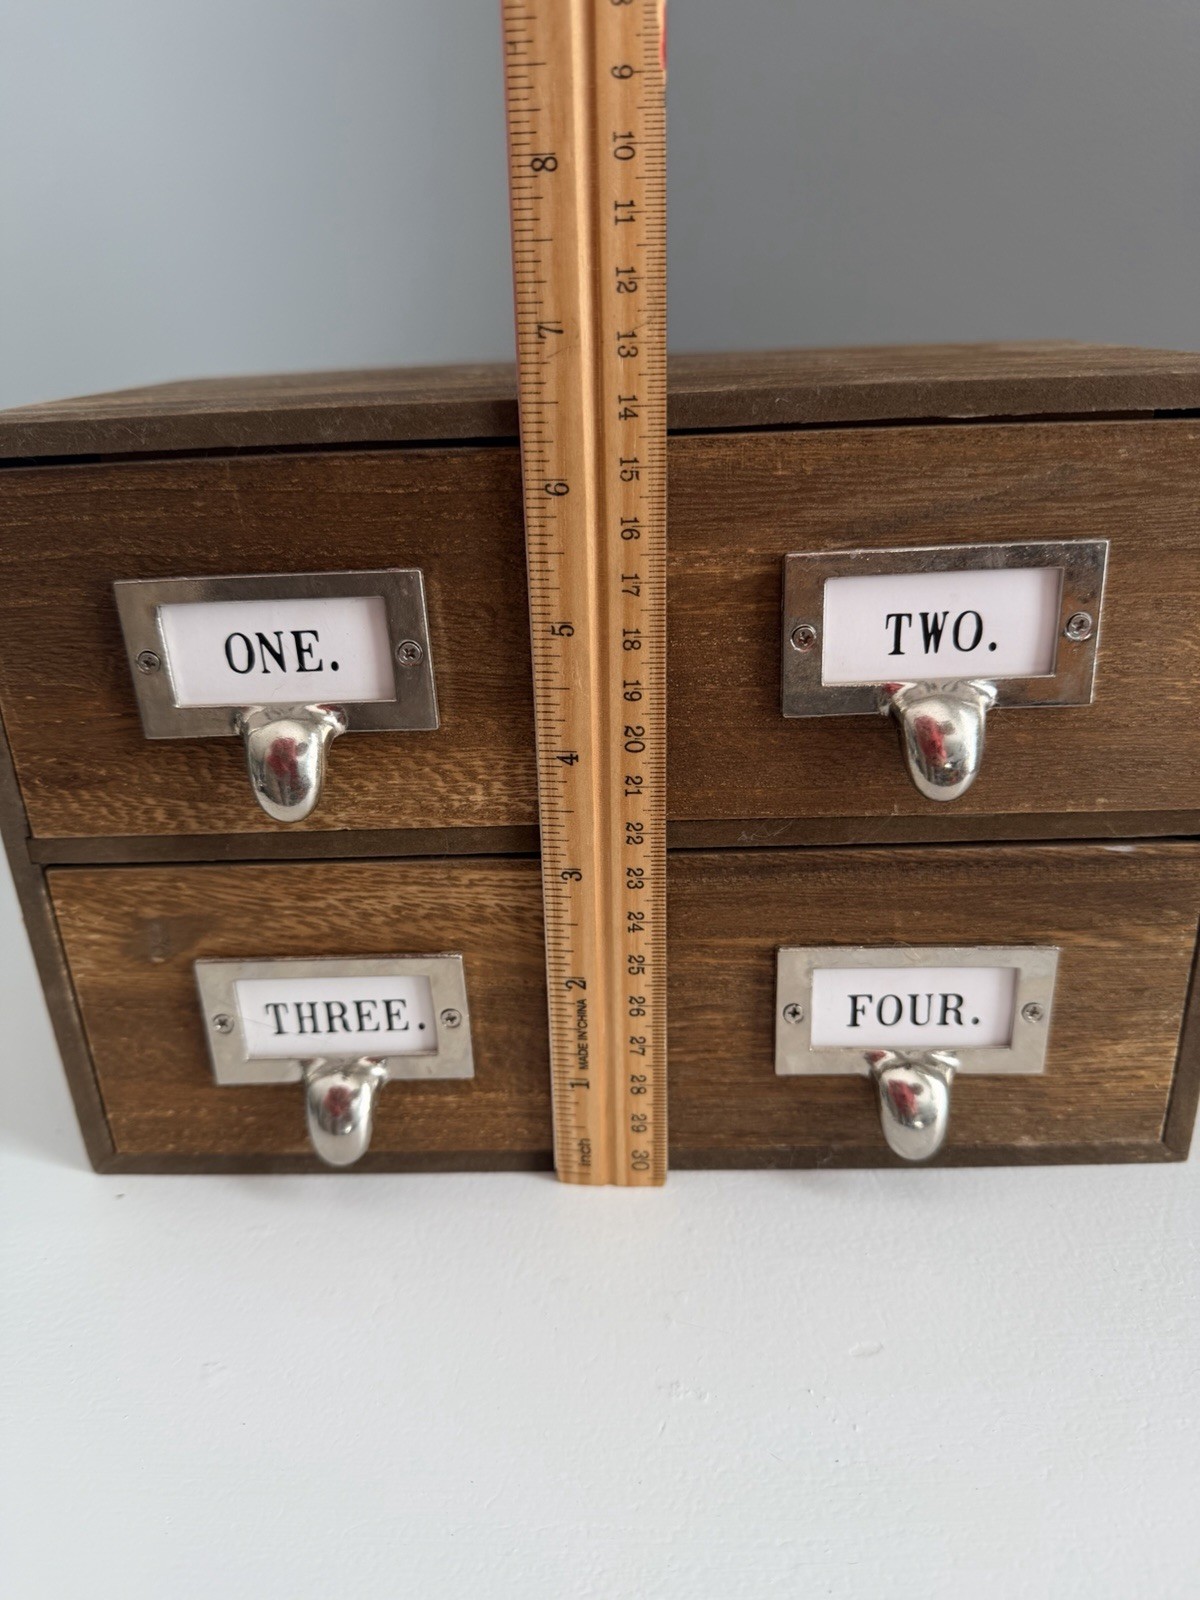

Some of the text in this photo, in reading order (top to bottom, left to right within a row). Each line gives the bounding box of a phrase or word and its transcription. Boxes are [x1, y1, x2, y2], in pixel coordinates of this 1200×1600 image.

[611, 64, 634, 79] 9
[613, 131, 636, 161] 10
[530, 156, 558, 172] 8
[614, 200, 636, 225] 11
[616, 267, 638, 294] 12
[537, 324, 564, 339] 7
[617, 331, 639, 359] 13
[618, 395, 639, 421] 14
[619, 457, 641, 482] 15
[544, 482, 570, 497] 6
[620, 517, 641, 540] 16
[621, 573, 641, 597] 17
[551, 625, 575, 638] 5
[622, 628, 641, 651] 18
[885, 610, 997, 655] TWO.
[224, 630, 339, 674] ONE.
[623, 679, 642, 702] 19
[624, 725, 646, 754] 20
[556, 754, 579, 766] 4
[624, 775, 643, 797] 21
[625, 822, 644, 845] 22
[561, 870, 582, 882] 3
[626, 868, 644, 890] 23
[627, 911, 645, 933] 24
[627, 955, 645, 976] 25
[565, 979, 587, 990] 2
[265, 998, 426, 1035] THREE.
[628, 996, 646, 1017] 26
[846, 993, 980, 1027] FOUR.
[577, 998, 589, 1070] MADE IN CHINA
[629, 1036, 646, 1056] 27
[569, 1080, 590, 1090] 1
[630, 1075, 647, 1095] 28
[631, 1114, 647, 1133] 29
[578, 1138, 591, 1167] inch
[631, 1150, 649, 1171] 30
